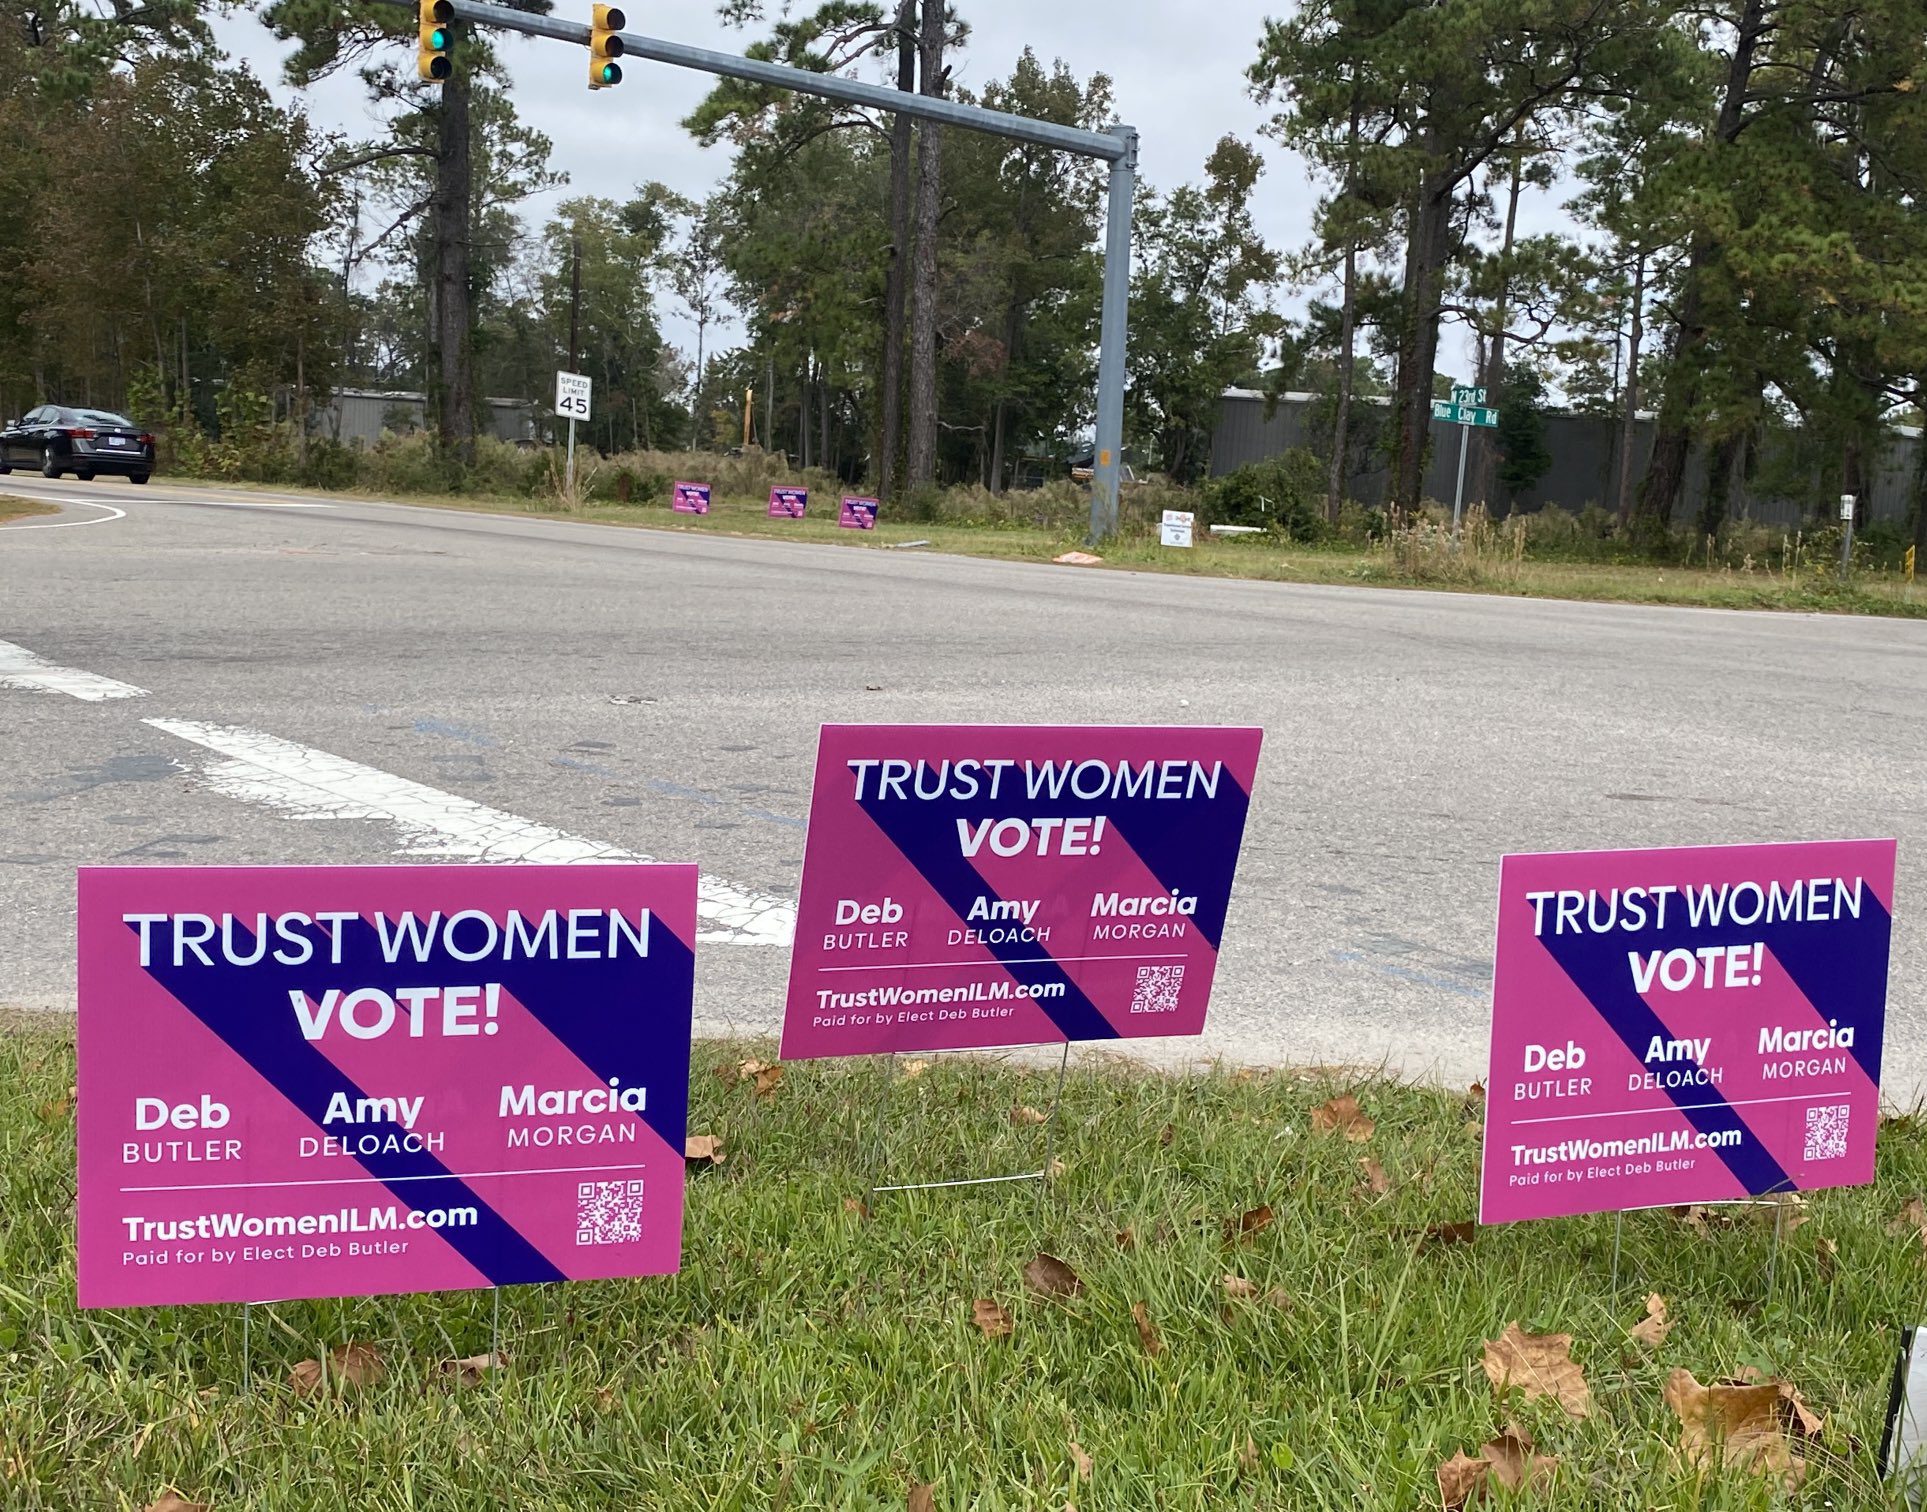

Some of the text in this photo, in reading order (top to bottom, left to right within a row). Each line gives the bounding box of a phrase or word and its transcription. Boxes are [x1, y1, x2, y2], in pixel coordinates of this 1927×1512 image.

[560, 377, 588, 389] SPEED
[563, 386, 585, 396] LIMIT
[1450, 388, 1487, 404] N 23rd St
[560, 396, 587, 414] 45
[1434, 403, 1498, 424] Blue Clay Rd
[846, 758, 1222, 801] TRUST WOMEN
[956, 815, 1107, 858] VOTE!
[835, 897, 904, 926] Deb
[966, 895, 1041, 925] Amy
[1090, 888, 1198, 917] Marcia
[1525, 876, 1863, 936] TRUST WOMEN
[122, 907, 650, 967] TRUST WOMEN
[823, 931, 908, 950] BUTLER
[947, 926, 1051, 945] DELOACH
[1093, 922, 1186, 940] MORGAN
[1627, 941, 1765, 994] VOTE!
[816, 981, 1066, 1010] TrustWomenILM.com
[288, 982, 501, 1041] VOTE!
[813, 1006, 1014, 1027] Paid for by Elect Deb Butler
[1644, 1035, 1712, 1066] Amy
[1757, 1018, 1855, 1055] Marcia
[1523, 1040, 1586, 1073] Deb
[1762, 1056, 1846, 1080] MORGAN
[1514, 1077, 1593, 1101] BUTLER
[1628, 1067, 1723, 1091] DELOACH
[322, 1091, 425, 1130] Amy
[498, 1076, 647, 1118] Marcia
[135, 1094, 231, 1131] Deb
[299, 1131, 444, 1158] DELOACH
[507, 1122, 636, 1148] MORGAN
[1510, 1129, 1742, 1167] TrustWomenILM.com
[123, 1139, 242, 1164] BUTLER
[1509, 1158, 1695, 1187] Paid for by Elect Deb Butler
[121, 1206, 478, 1243] TrustWomenILM.com
[122, 1240, 409, 1267] Paid for by Elect Deb Butler
